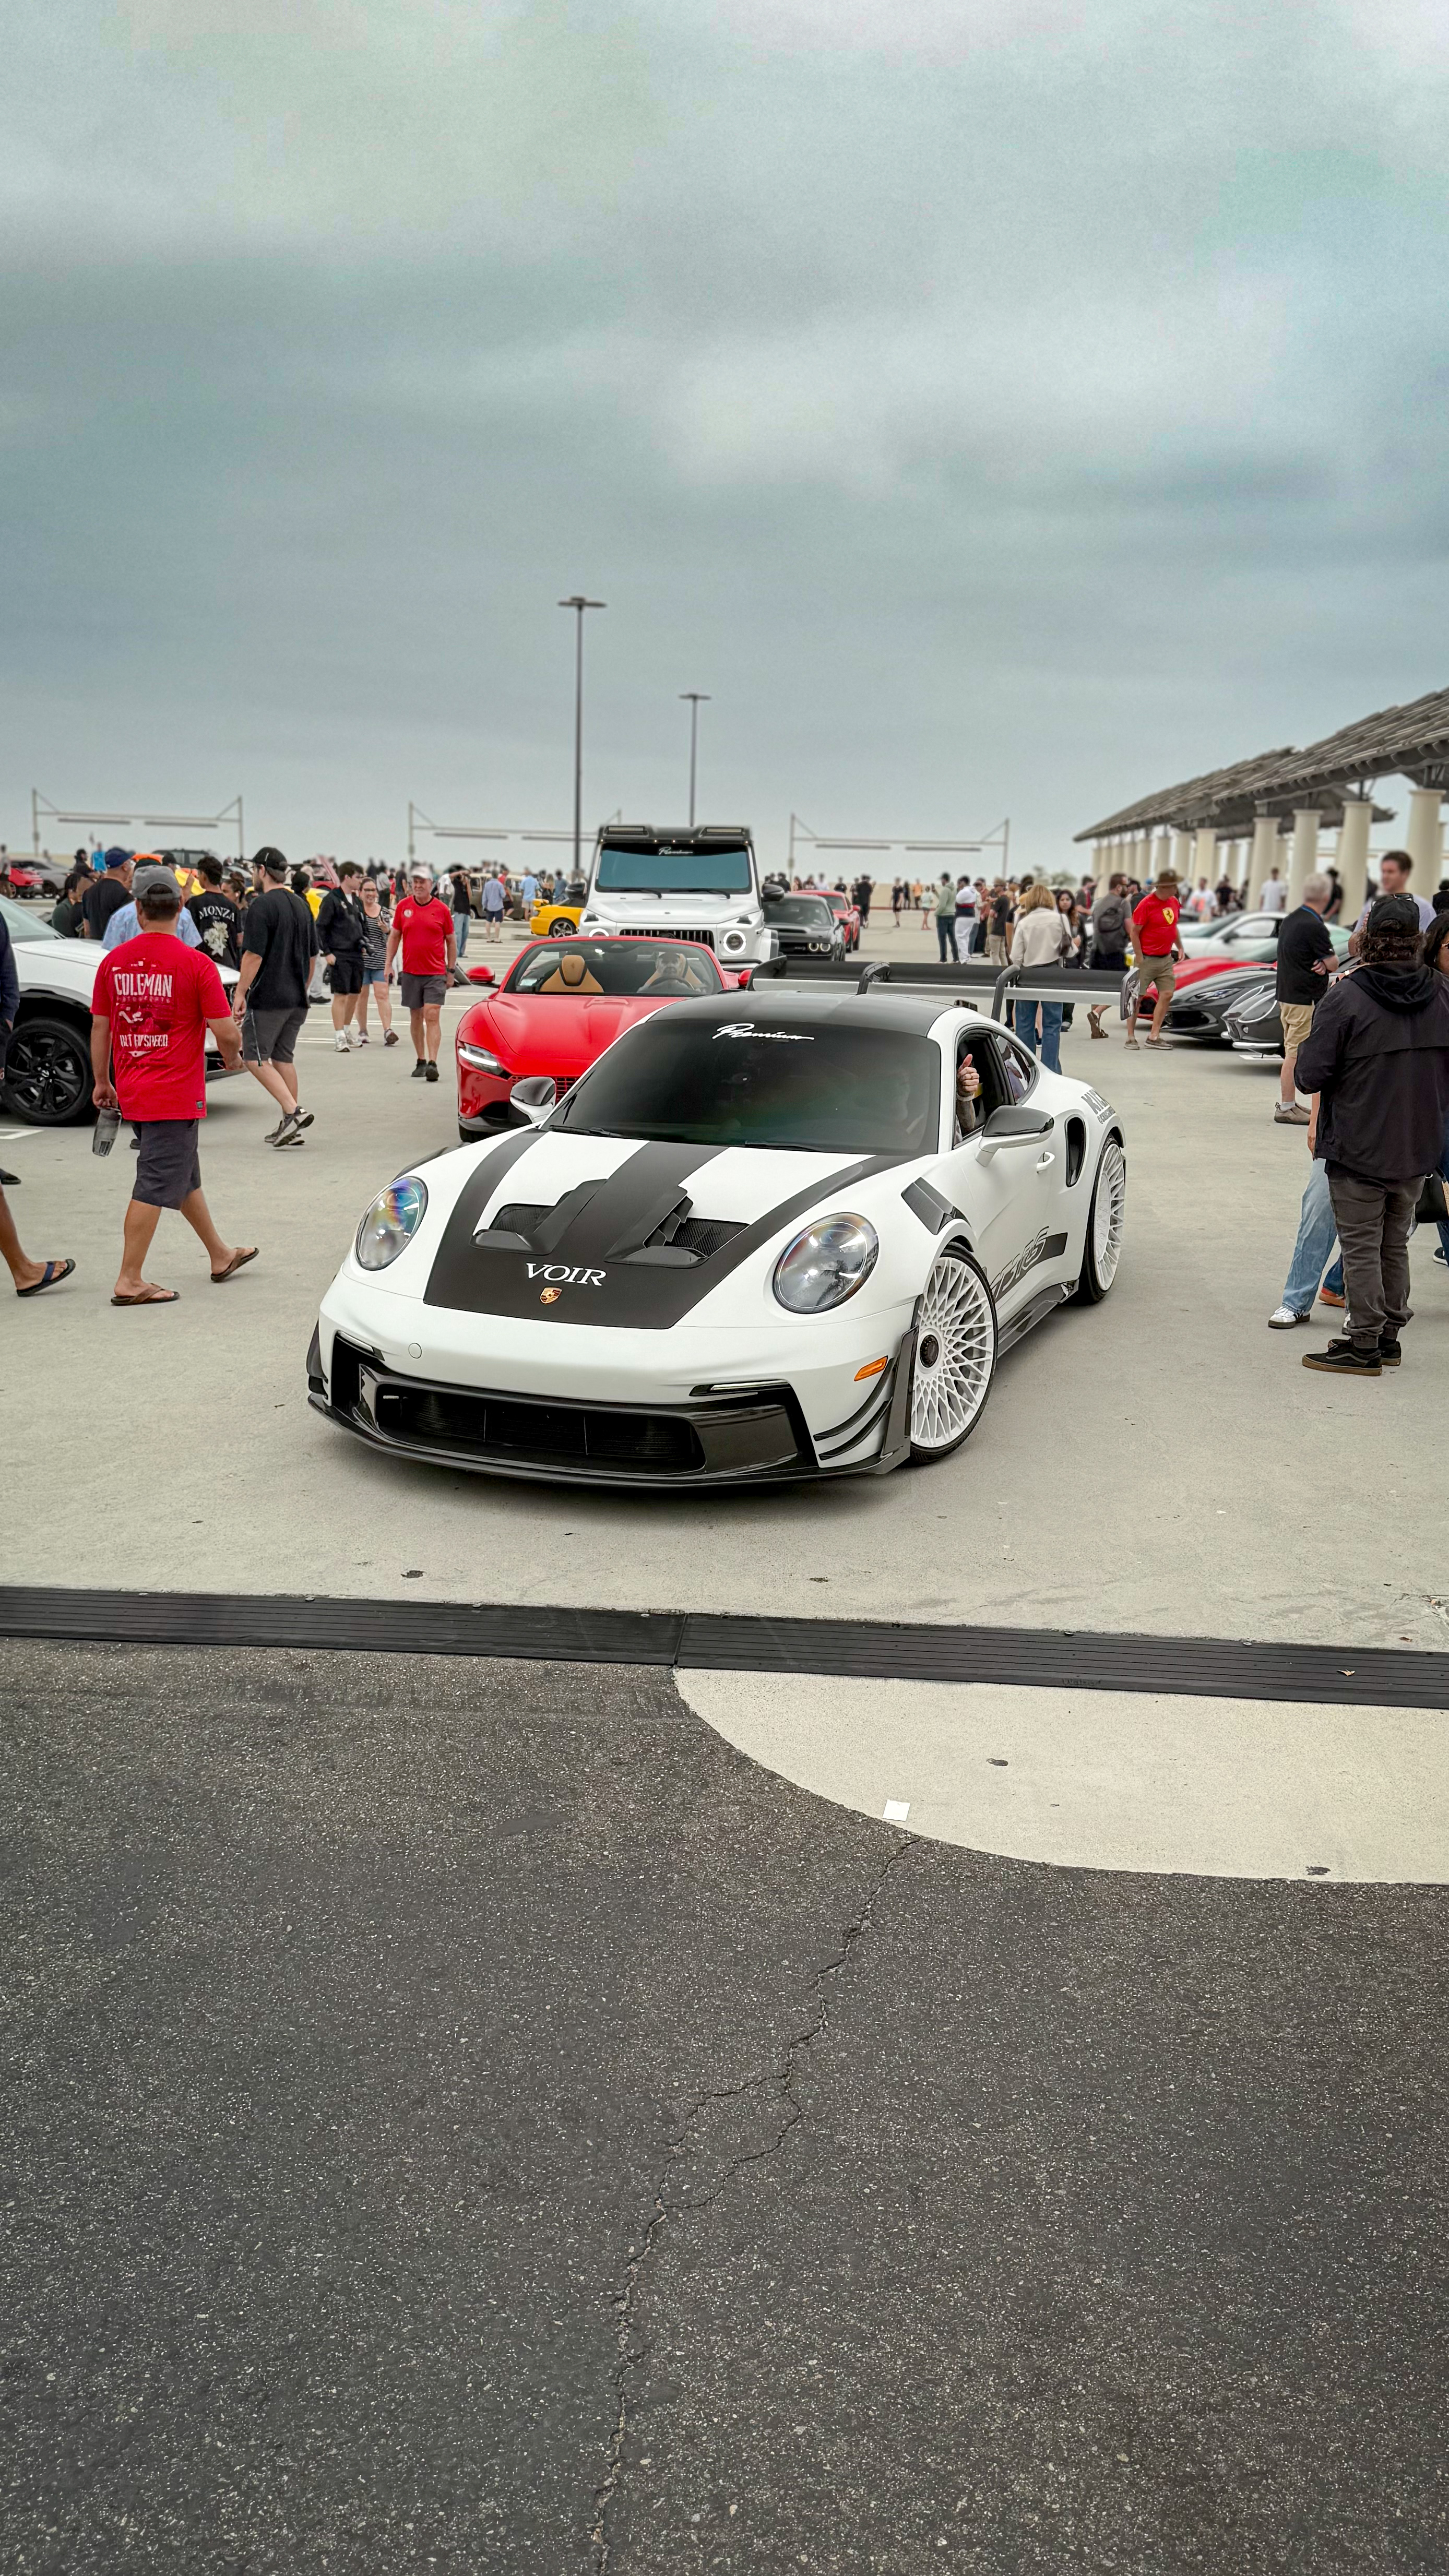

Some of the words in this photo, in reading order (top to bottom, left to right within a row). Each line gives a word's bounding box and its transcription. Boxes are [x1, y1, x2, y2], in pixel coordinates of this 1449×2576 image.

[199, 905, 234, 922] MONZA
[114, 973, 172, 997] COLEMAN
[712, 1023, 815, 1040] Premium
[526, 1262, 607, 1286] VOIR
